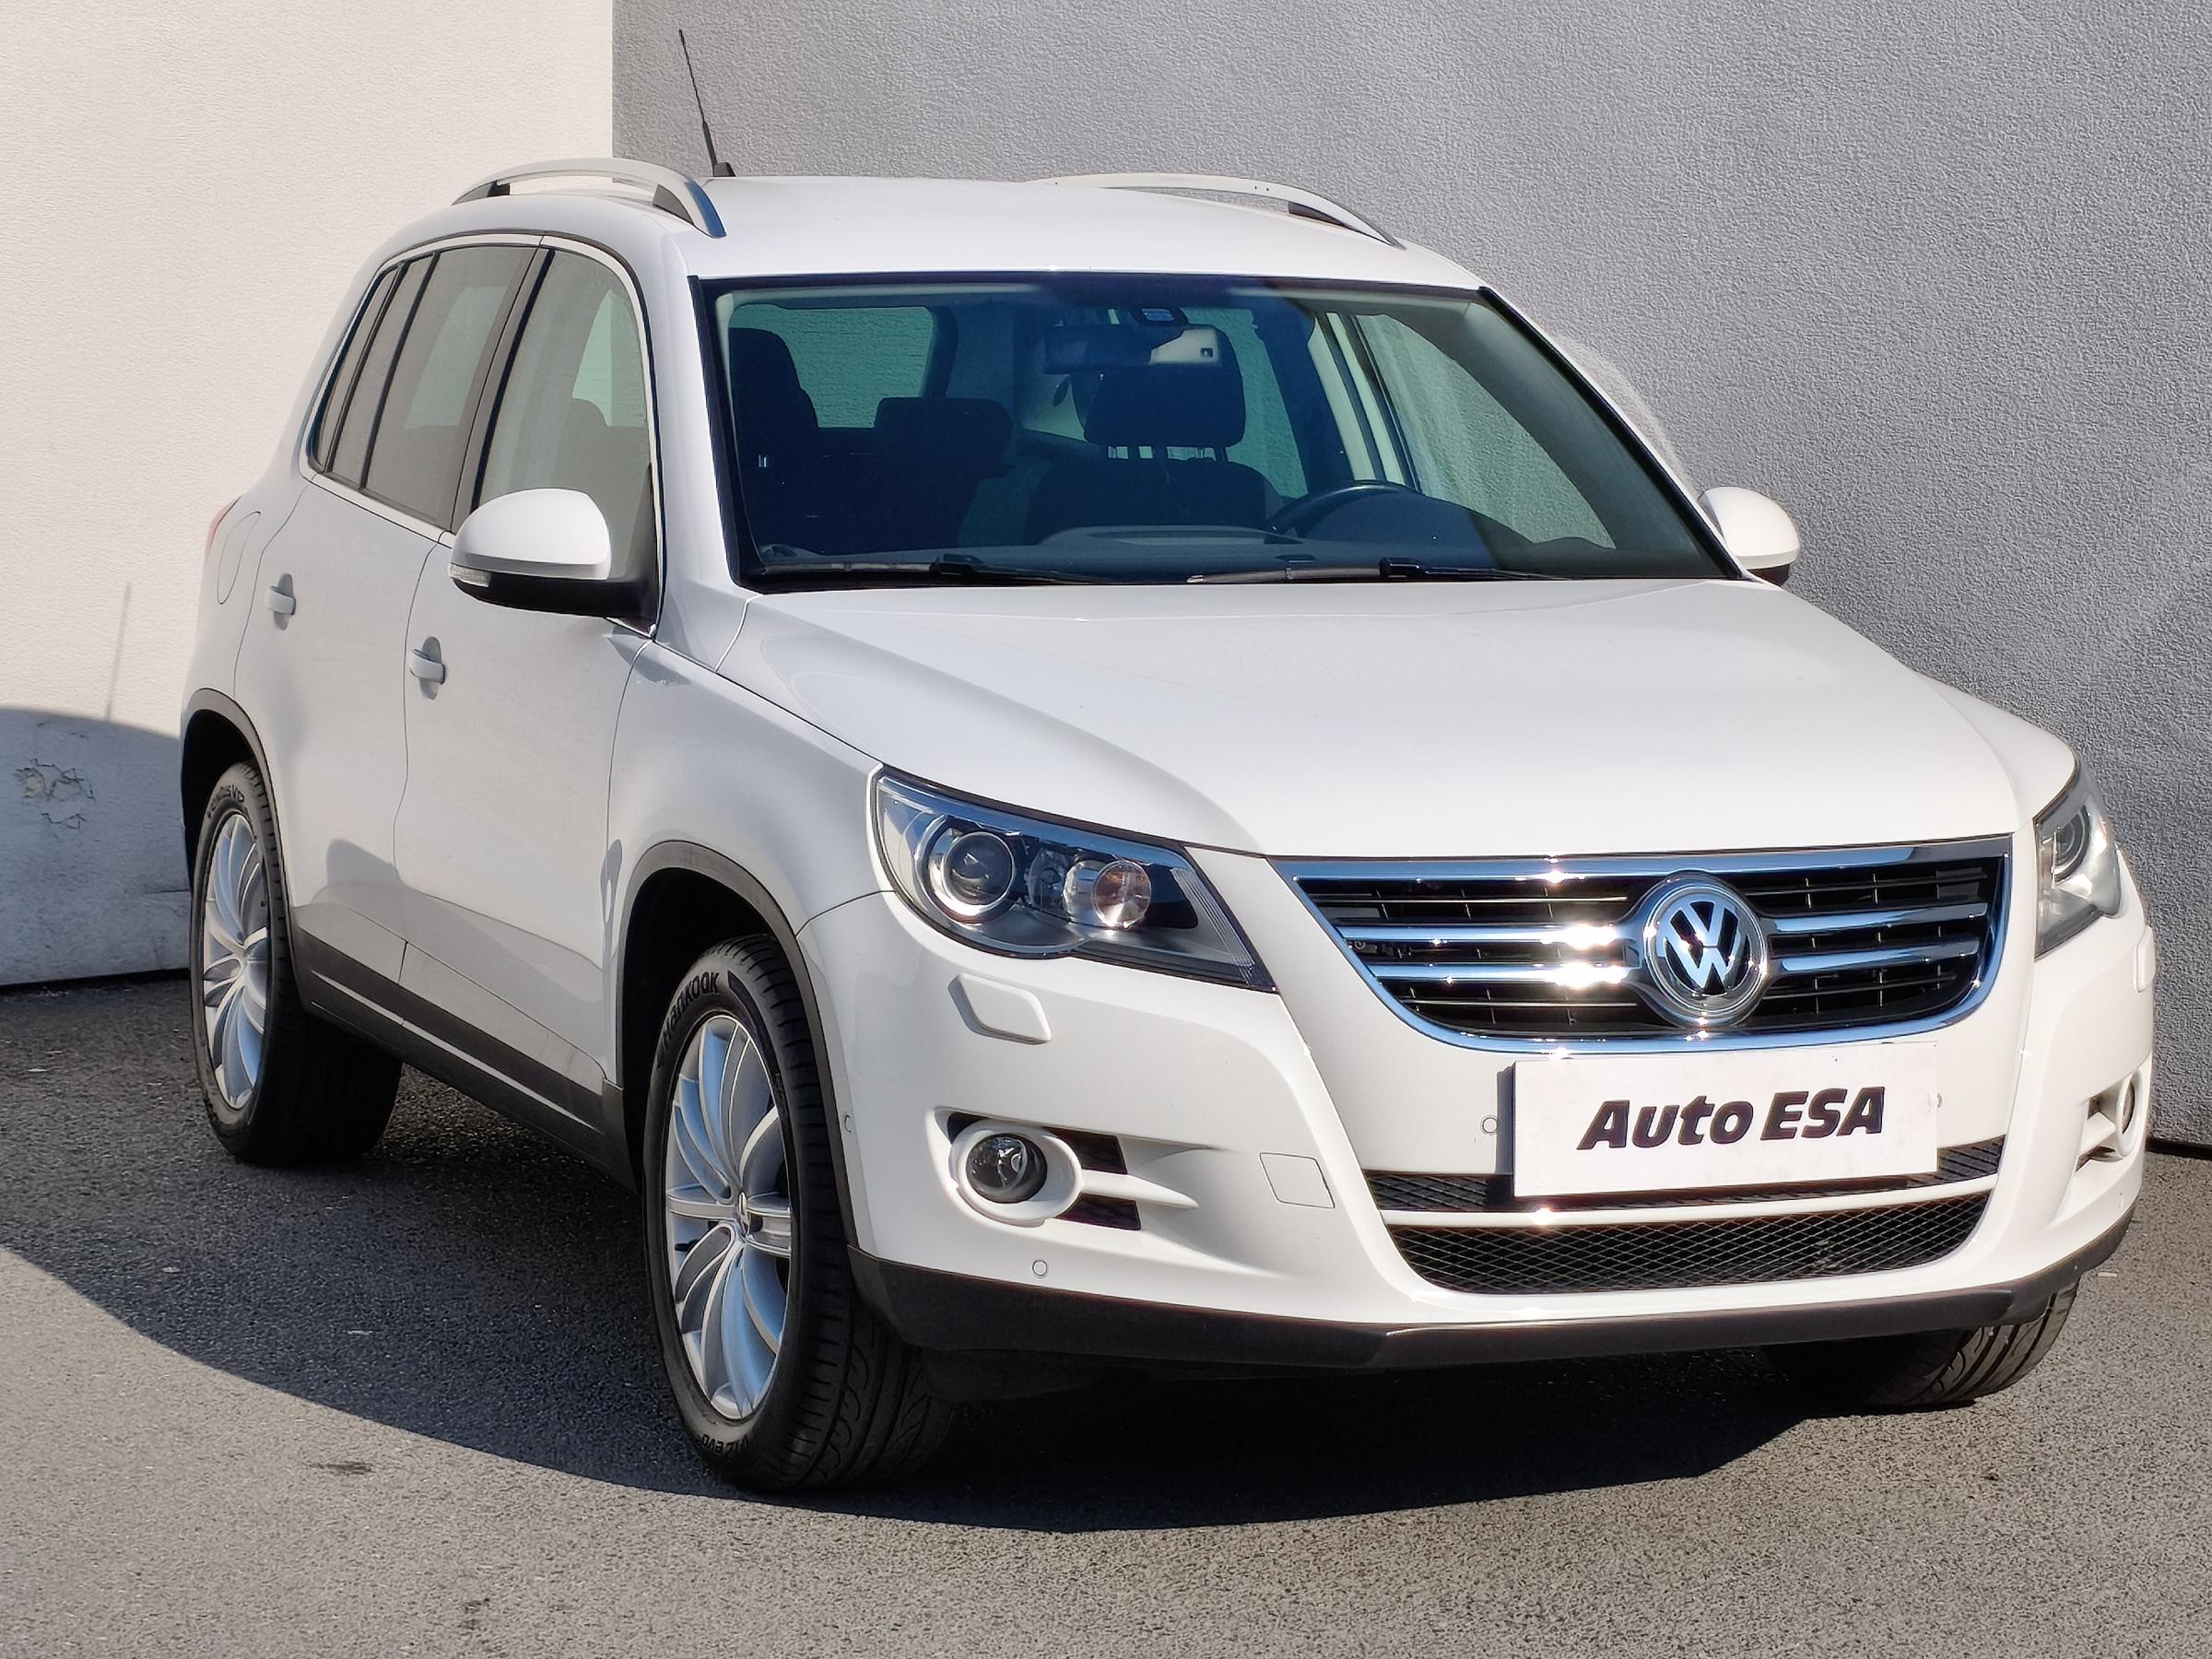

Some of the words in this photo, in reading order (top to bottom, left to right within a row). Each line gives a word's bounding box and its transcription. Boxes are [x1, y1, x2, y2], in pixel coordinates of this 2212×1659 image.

[1660, 899, 1752, 997] VW
[1576, 1095, 1753, 1150] Auto
[1759, 1086, 1886, 1140] ESA
